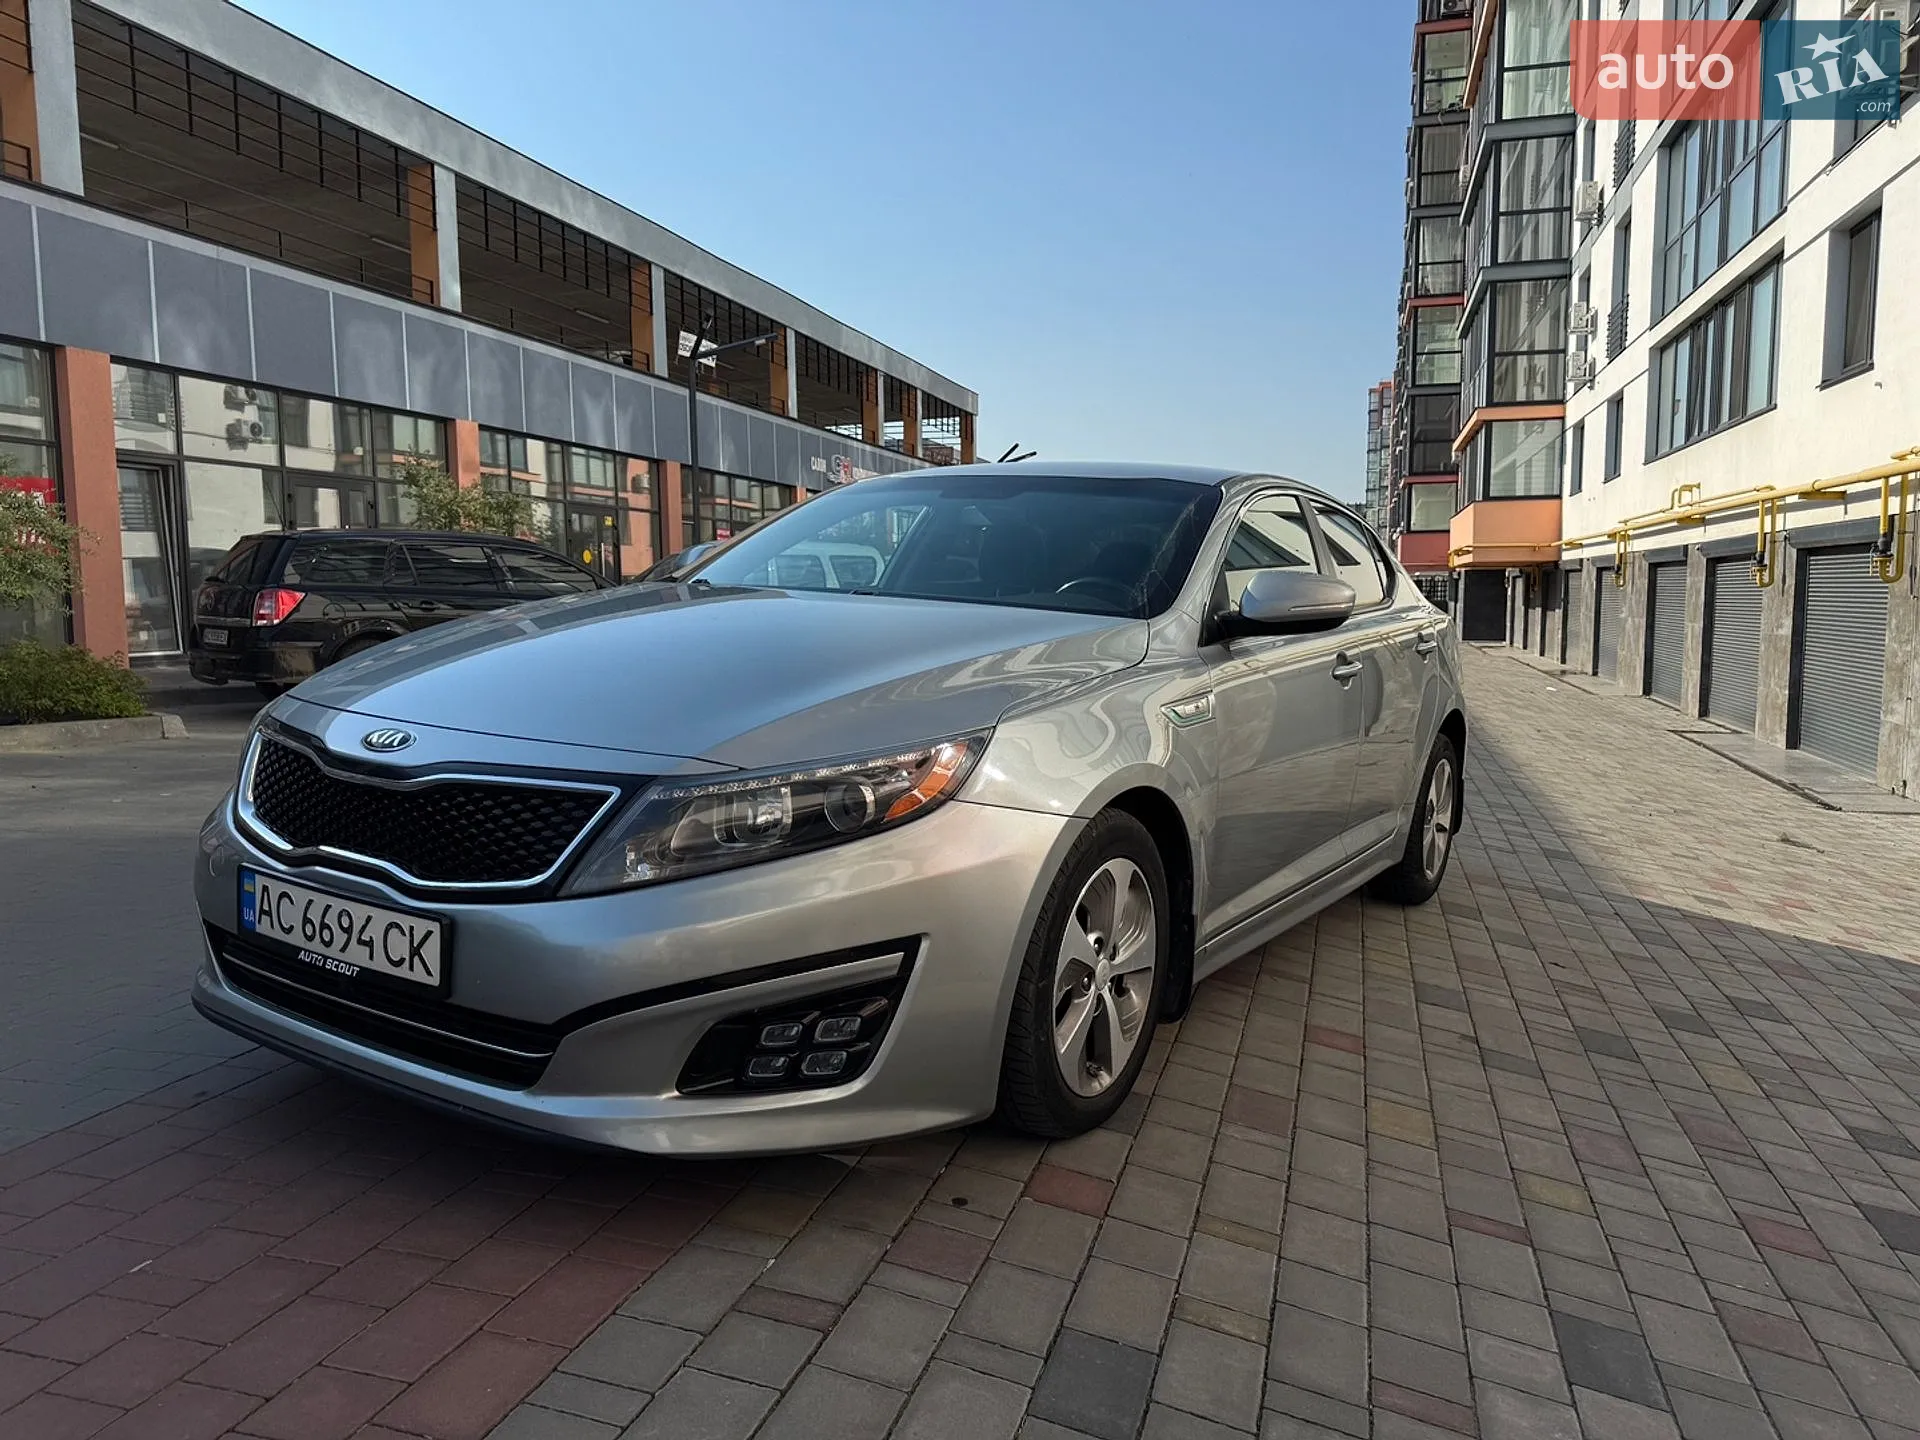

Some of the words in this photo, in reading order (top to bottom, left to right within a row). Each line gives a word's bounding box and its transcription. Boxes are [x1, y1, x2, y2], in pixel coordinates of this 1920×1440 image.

[367, 729, 404, 746] KIA
[243, 911, 255, 922] UA
[297, 950, 324, 967] AUTO
[324, 957, 361, 977] SCOUT
